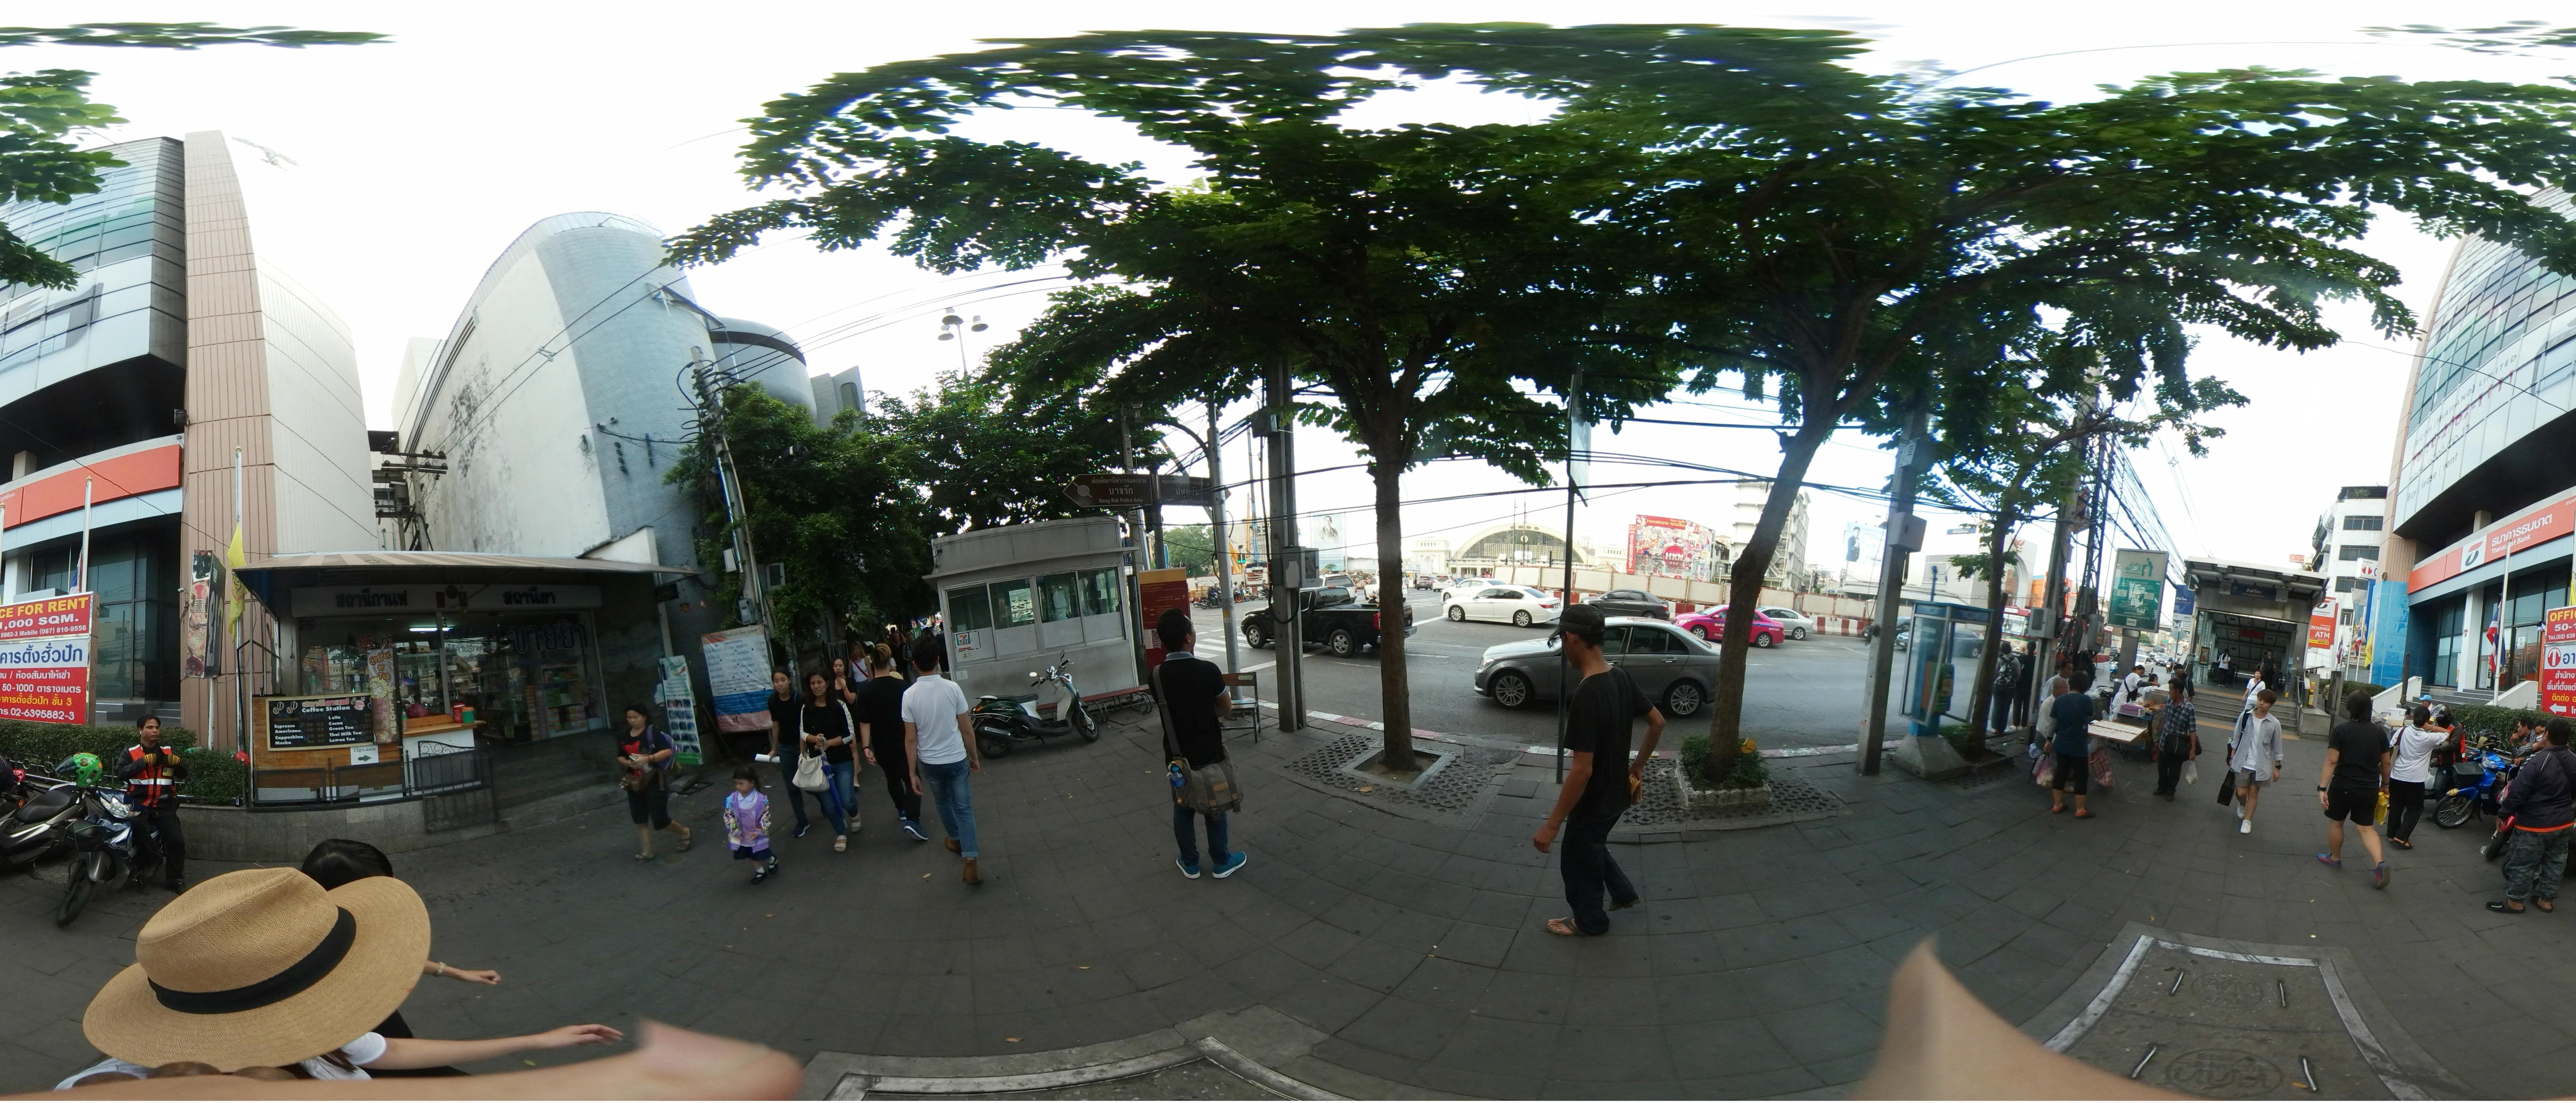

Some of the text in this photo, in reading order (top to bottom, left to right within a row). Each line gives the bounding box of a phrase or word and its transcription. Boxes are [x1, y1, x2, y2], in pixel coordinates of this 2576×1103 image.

[2478, 354, 2517, 387] LIMITED
[2421, 472, 2437, 489] lease
[2443, 452, 2458, 471] rent
[1109, 485, 1133, 495] บางรัก
[2491, 514, 2552, 547] ธนาคารธนชาต
[2491, 534, 2531, 554] Thanacrt Bank
[1665, 552, 1684, 561] HKN
[336, 588, 408, 607] สถานีกาแฟ
[17, 603, 43, 616] FOR
[48, 597, 88, 613] RENT
[38, 614, 79, 625] SQM.
[2550, 609, 2576, 622] OFFI
[39, 627, 55, 635] (087)
[369, 651, 392, 665] Coffee
[10, 671, 13, 679] /
[2555, 671, 2576, 679] สำนักง
[2, 683, 34, 692] 50-1000
[0, 693, 72, 706] าคารตั้งฮั่วปัก ชั้น 3
[2552, 693, 2569, 702] ติดต่อ
[387, 686, 397, 735] WELCOME
